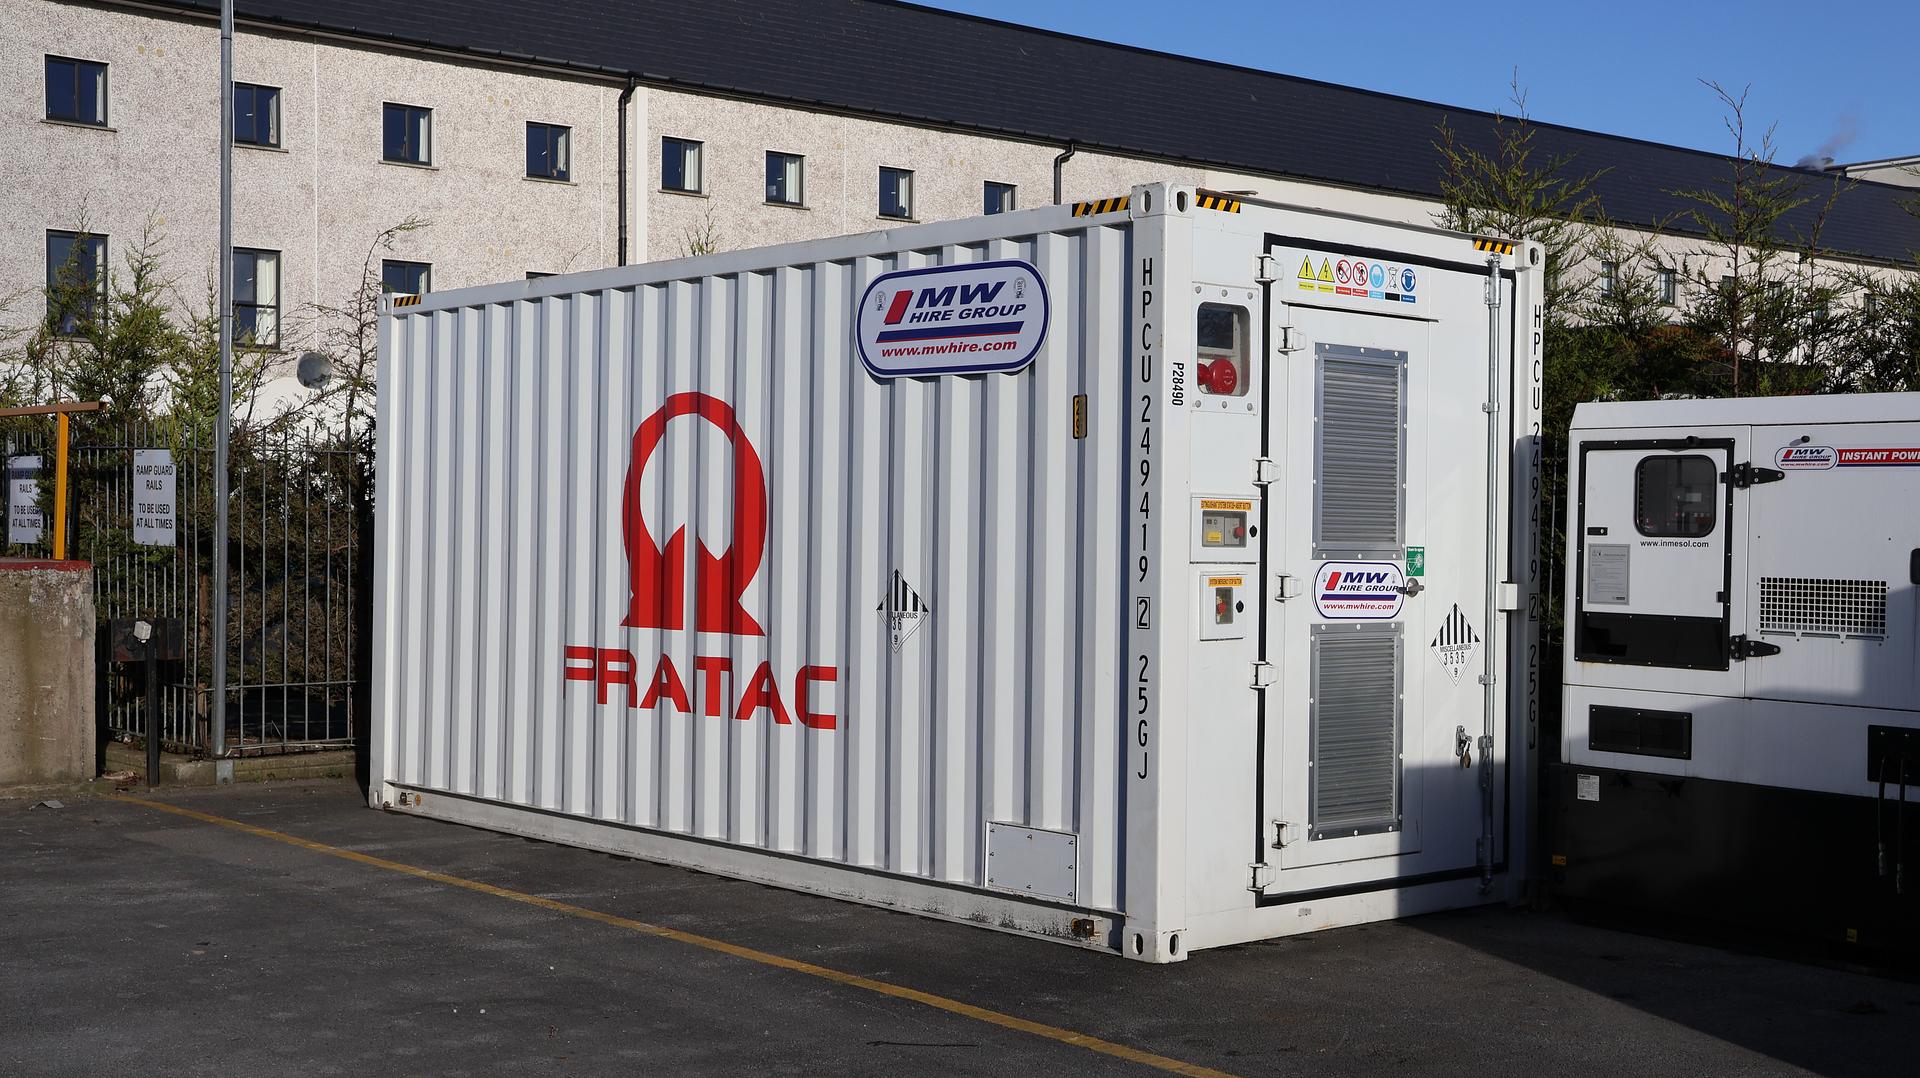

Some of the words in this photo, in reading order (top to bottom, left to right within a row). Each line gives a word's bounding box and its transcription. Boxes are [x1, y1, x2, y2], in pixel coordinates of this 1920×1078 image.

[915, 281, 1007, 309] MW
[909, 309, 954, 324] HIRE
[958, 303, 1027, 320] GROUP
[1141, 258, 1153, 383] HPCU
[881, 340, 1017, 358] www.mwhire.com
[1533, 304, 1541, 410] HPCU
[1171, 362, 1185, 406] P28490
[1841, 451, 1889, 460] INSTANT
[136, 465, 152, 476] RAMP
[154, 465, 173, 476] GUARD
[19, 483, 32, 493] RAILS
[146, 479, 162, 490] RAILS
[1139, 395, 1152, 583] 249419
[139, 503, 146, 514] TO
[147, 503, 154, 514] BE
[155, 503, 170, 514] USED
[1530, 422, 1540, 583] 249419
[14, 505, 20, 514] TO
[20, 505, 26, 514] BE
[12, 518, 18, 528] AT
[18, 518, 26, 528] ALL
[27, 518, 41, 529] TIMES
[136, 518, 143, 528] AT
[144, 518, 154, 528] ALL
[155, 518, 172, 529] TIMES
[1640, 539, 1709, 548] www.inmesol.com
[1342, 571, 1389, 583] MW
[1440, 643, 1472, 653] MISCELLANEOUS
[1444, 651, 1465, 666] 3536
[1137, 654, 1149, 780] 25GJ
